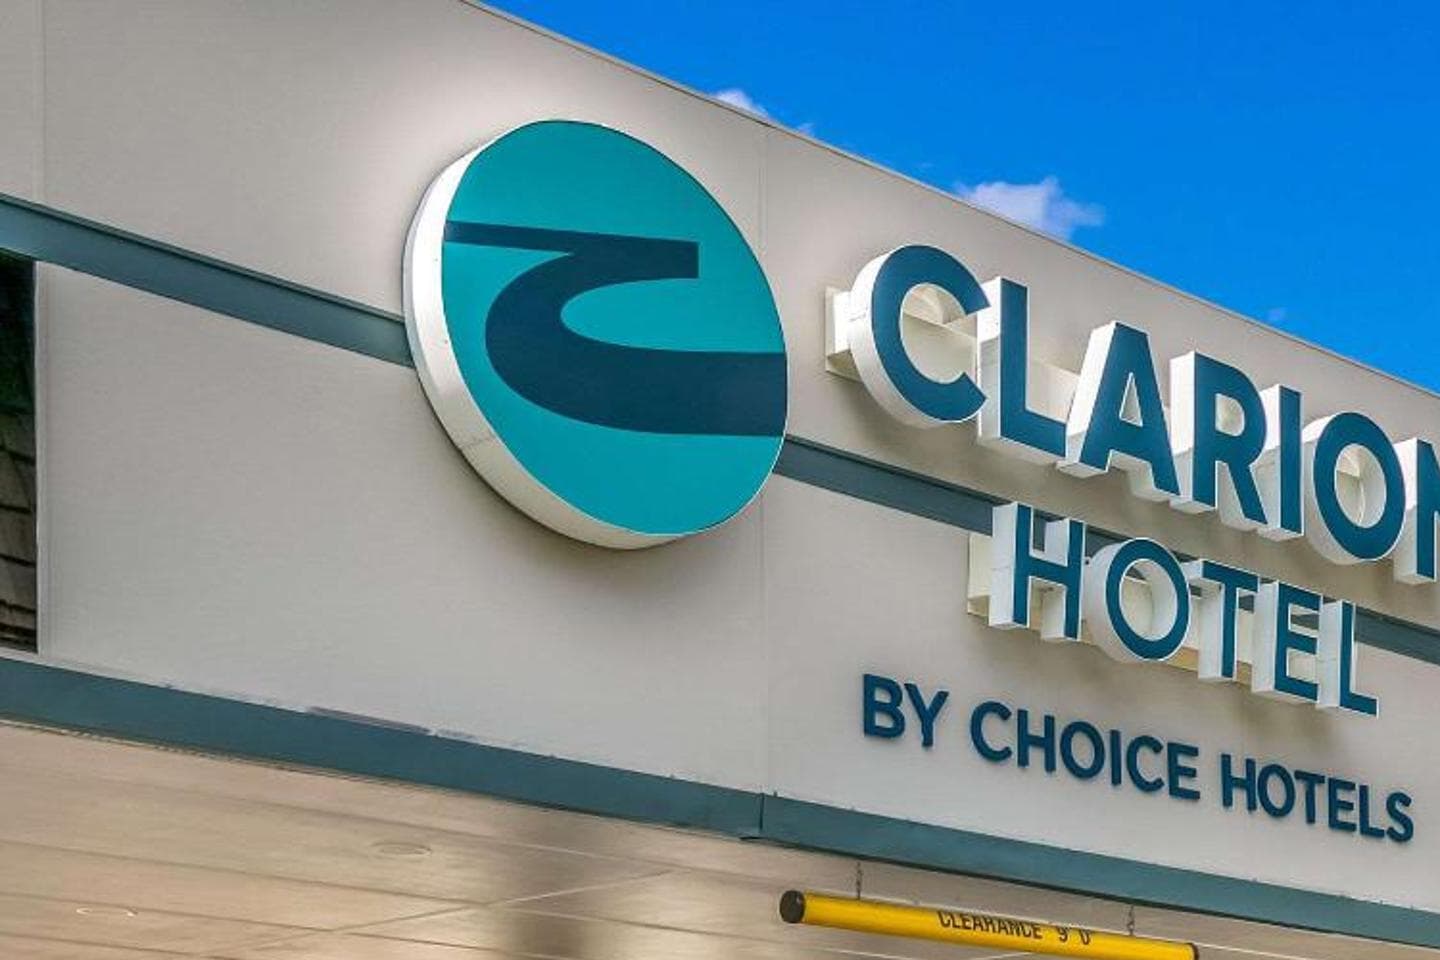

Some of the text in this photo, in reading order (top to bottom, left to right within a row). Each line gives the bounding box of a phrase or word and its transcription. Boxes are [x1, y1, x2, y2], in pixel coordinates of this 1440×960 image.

[1011, 504, 1379, 718] HOTEL
[863, 674, 1415, 843] BY CHOICE HOTELS
[937, 910, 1044, 940] CLEARANCE
